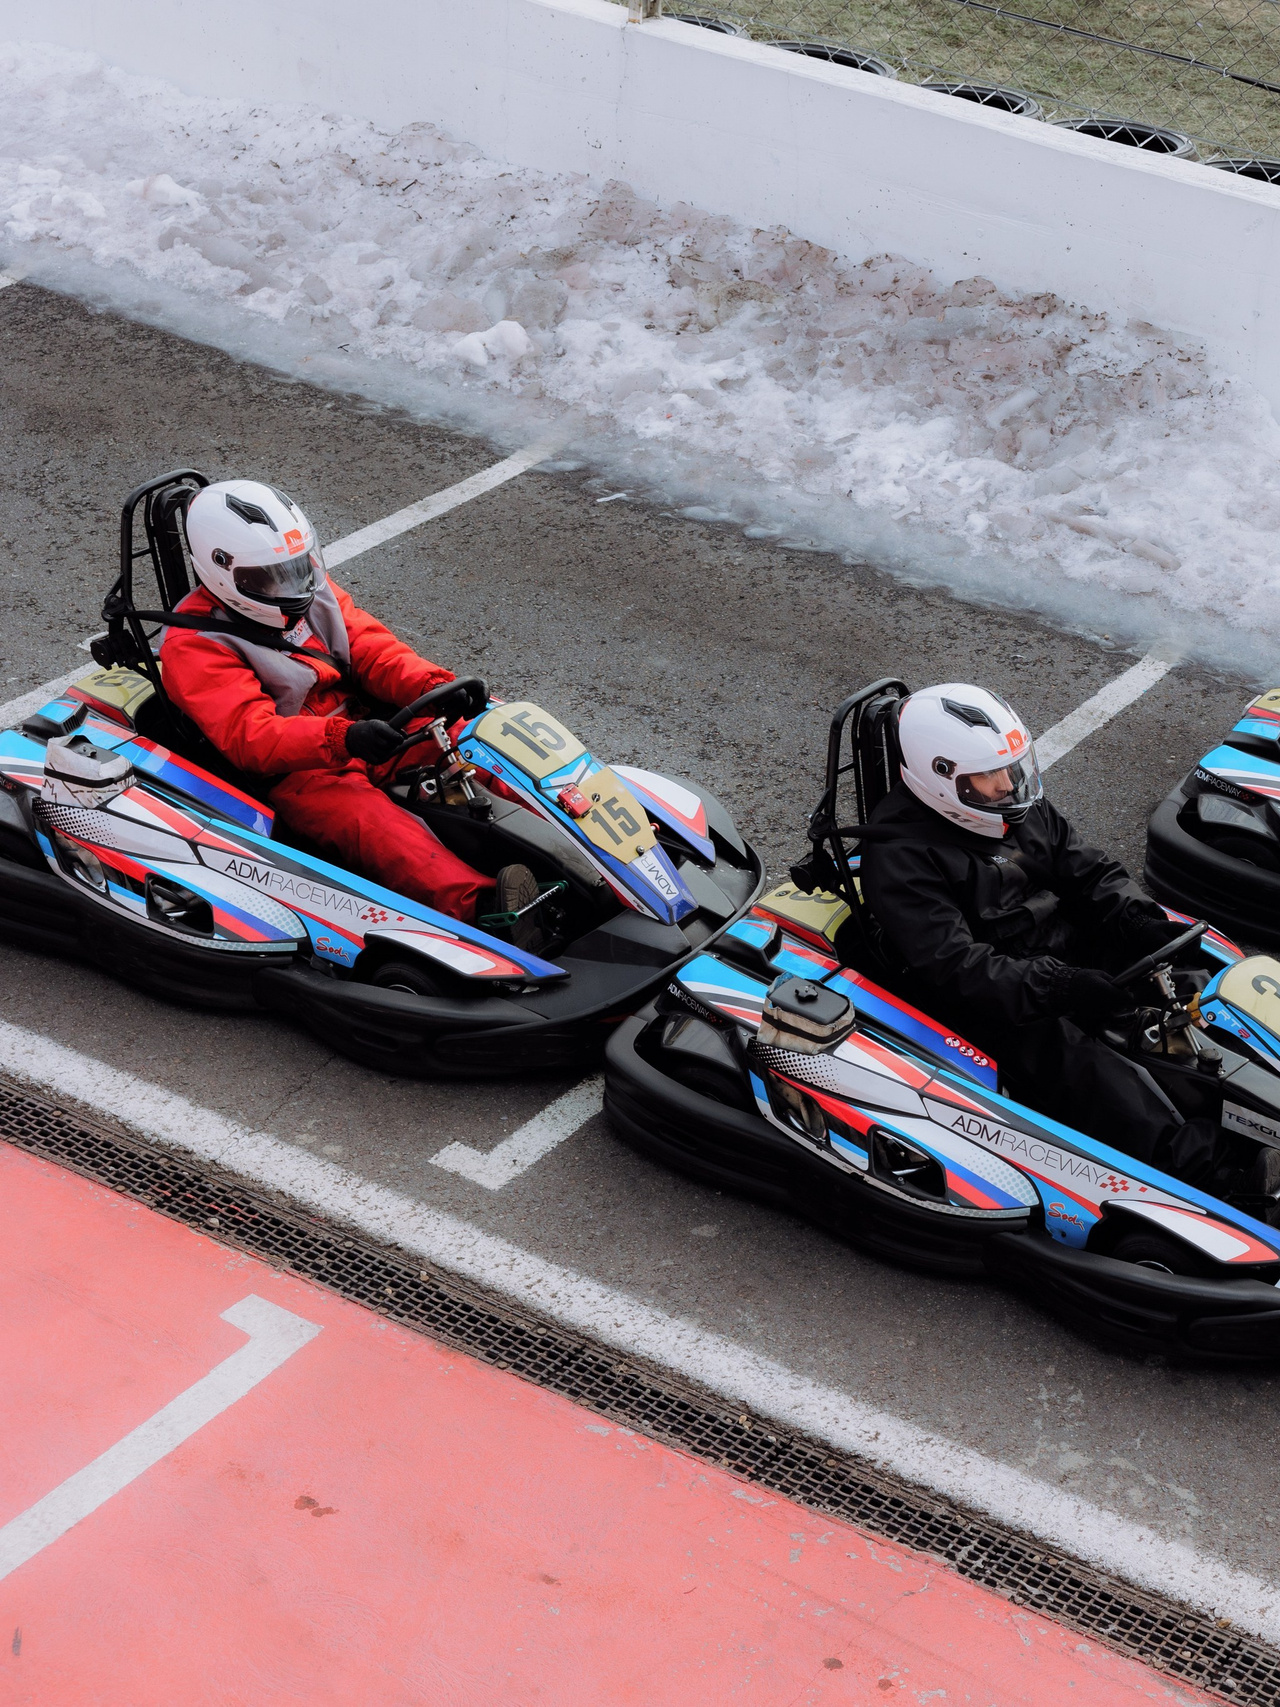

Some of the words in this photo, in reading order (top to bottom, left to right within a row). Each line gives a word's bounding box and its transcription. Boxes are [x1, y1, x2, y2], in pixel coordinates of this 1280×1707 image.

[501, 711, 566, 760] 15
[1194, 769, 1241, 797] ADMRACEWAY
[591, 796, 641, 846] 15
[225, 859, 367, 918] ADMRACEWAY
[667, 983, 710, 1018] ADMRACEWAY
[951, 1115, 1107, 1185] ADMRACEWAY
